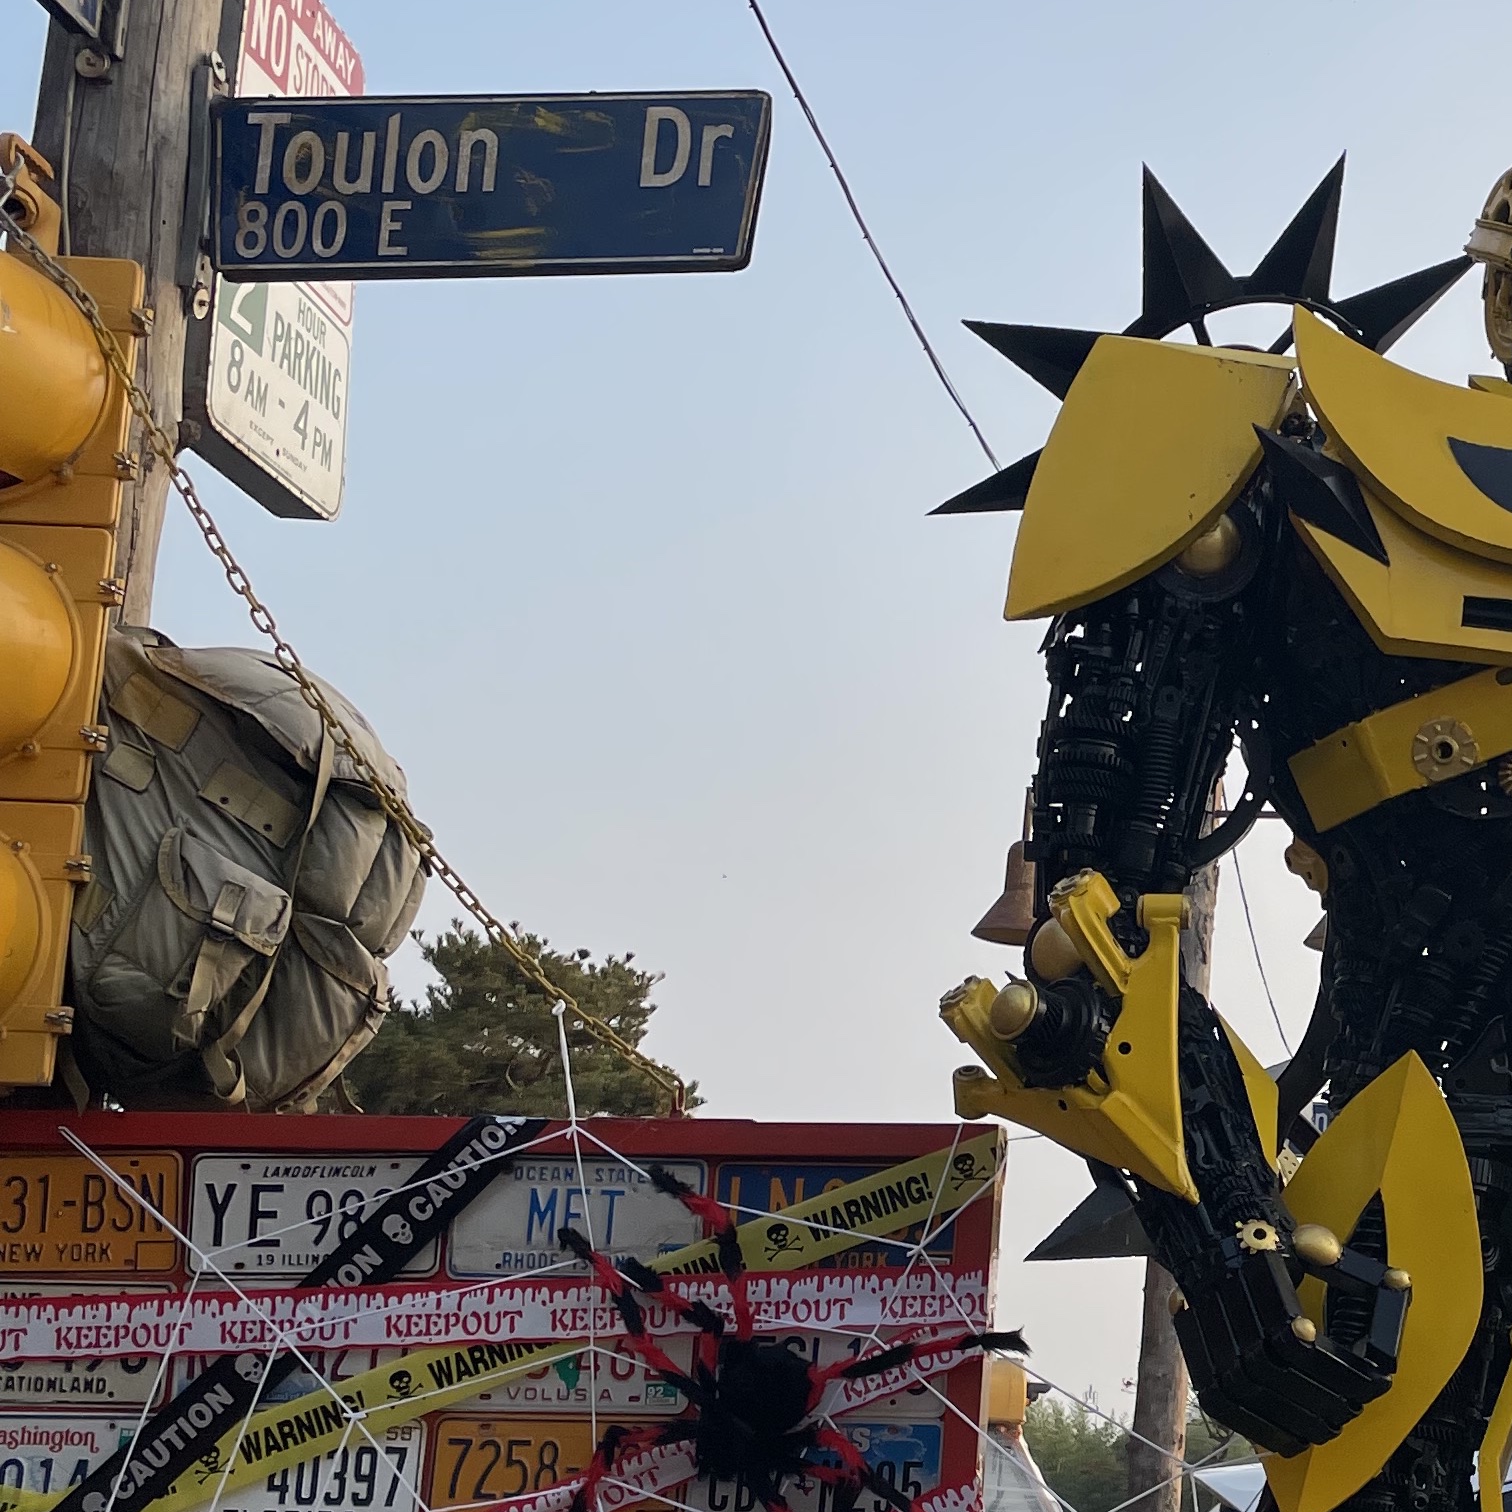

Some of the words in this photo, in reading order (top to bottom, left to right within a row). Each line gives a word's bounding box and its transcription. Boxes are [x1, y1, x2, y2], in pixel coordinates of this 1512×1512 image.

[250, 0, 288, 77] NO
[246, 111, 499, 196] Toulon
[638, 105, 735, 188] Dr
[234, 201, 348, 259] 800
[377, 200, 412, 256] E
[296, 297, 328, 350] HOUR
[271, 310, 343, 421] PARKING
[227, 339, 245, 395] 8
[244, 369, 269, 418] AM
[293, 400, 311, 451] 4
[312, 426, 334, 473] PM
[249, 420, 275, 446] EXCEPT
[282, 447, 308, 474] SUNDAY
[514, 1166, 575, 1183] OCEAN
[205, 1183, 285, 1248] YE
[803, 1172, 935, 1243] WARNING!
[56, 1242, 113, 1264] YORK
[384, 1309, 523, 1339] KEEPOUT
[550, 1304, 683, 1333] KEEPUT
[0, 1375, 108, 1395] ATIONLAND
[506, 1386, 613, 1401] VOLUSA
[0, 1425, 100, 1454] ashington
[110, 1382, 235, 1500] CAUTION
